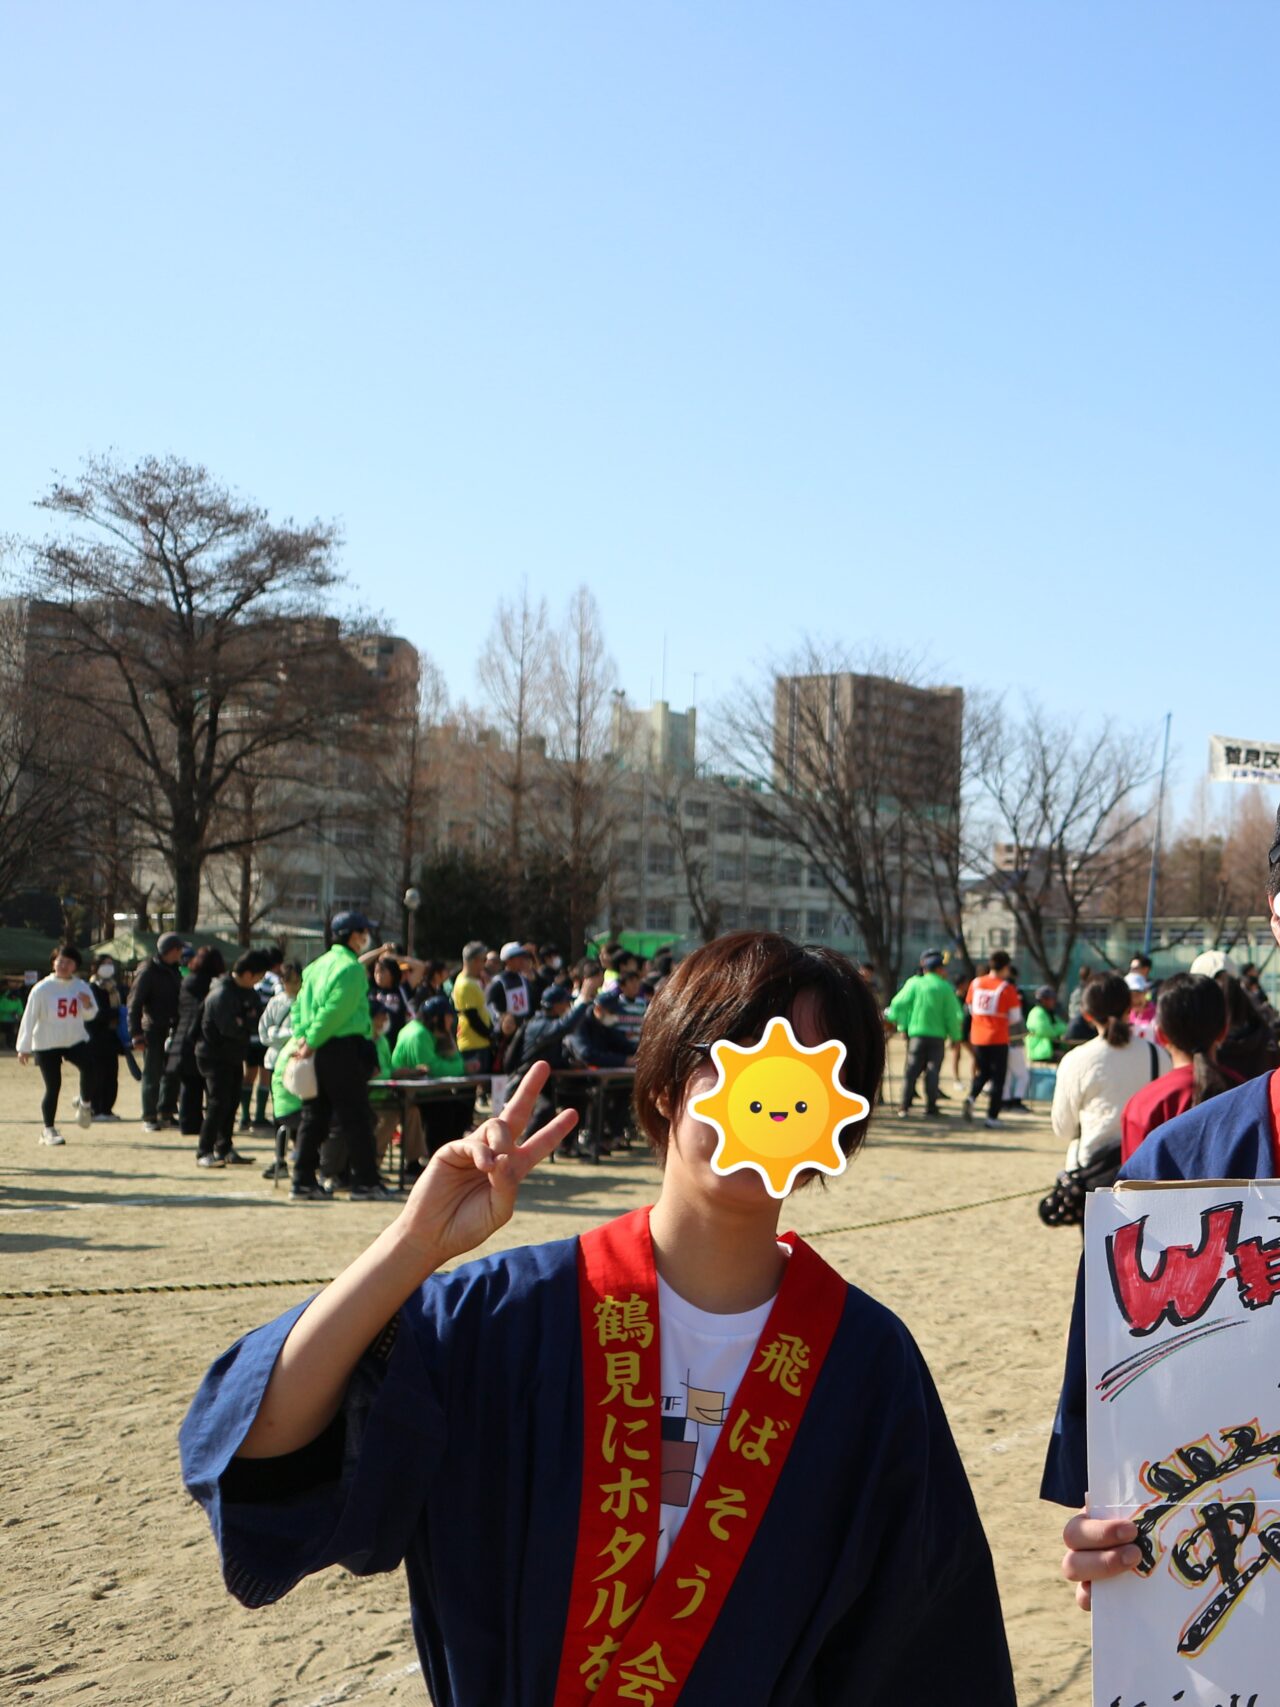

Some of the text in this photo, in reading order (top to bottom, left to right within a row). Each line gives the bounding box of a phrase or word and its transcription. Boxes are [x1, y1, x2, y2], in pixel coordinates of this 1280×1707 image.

[57, 998, 78, 1018] 54
[579, 1293, 656, 1693] 鶴見にホタルを
[617, 1333, 809, 1707] 飛ばそう会
